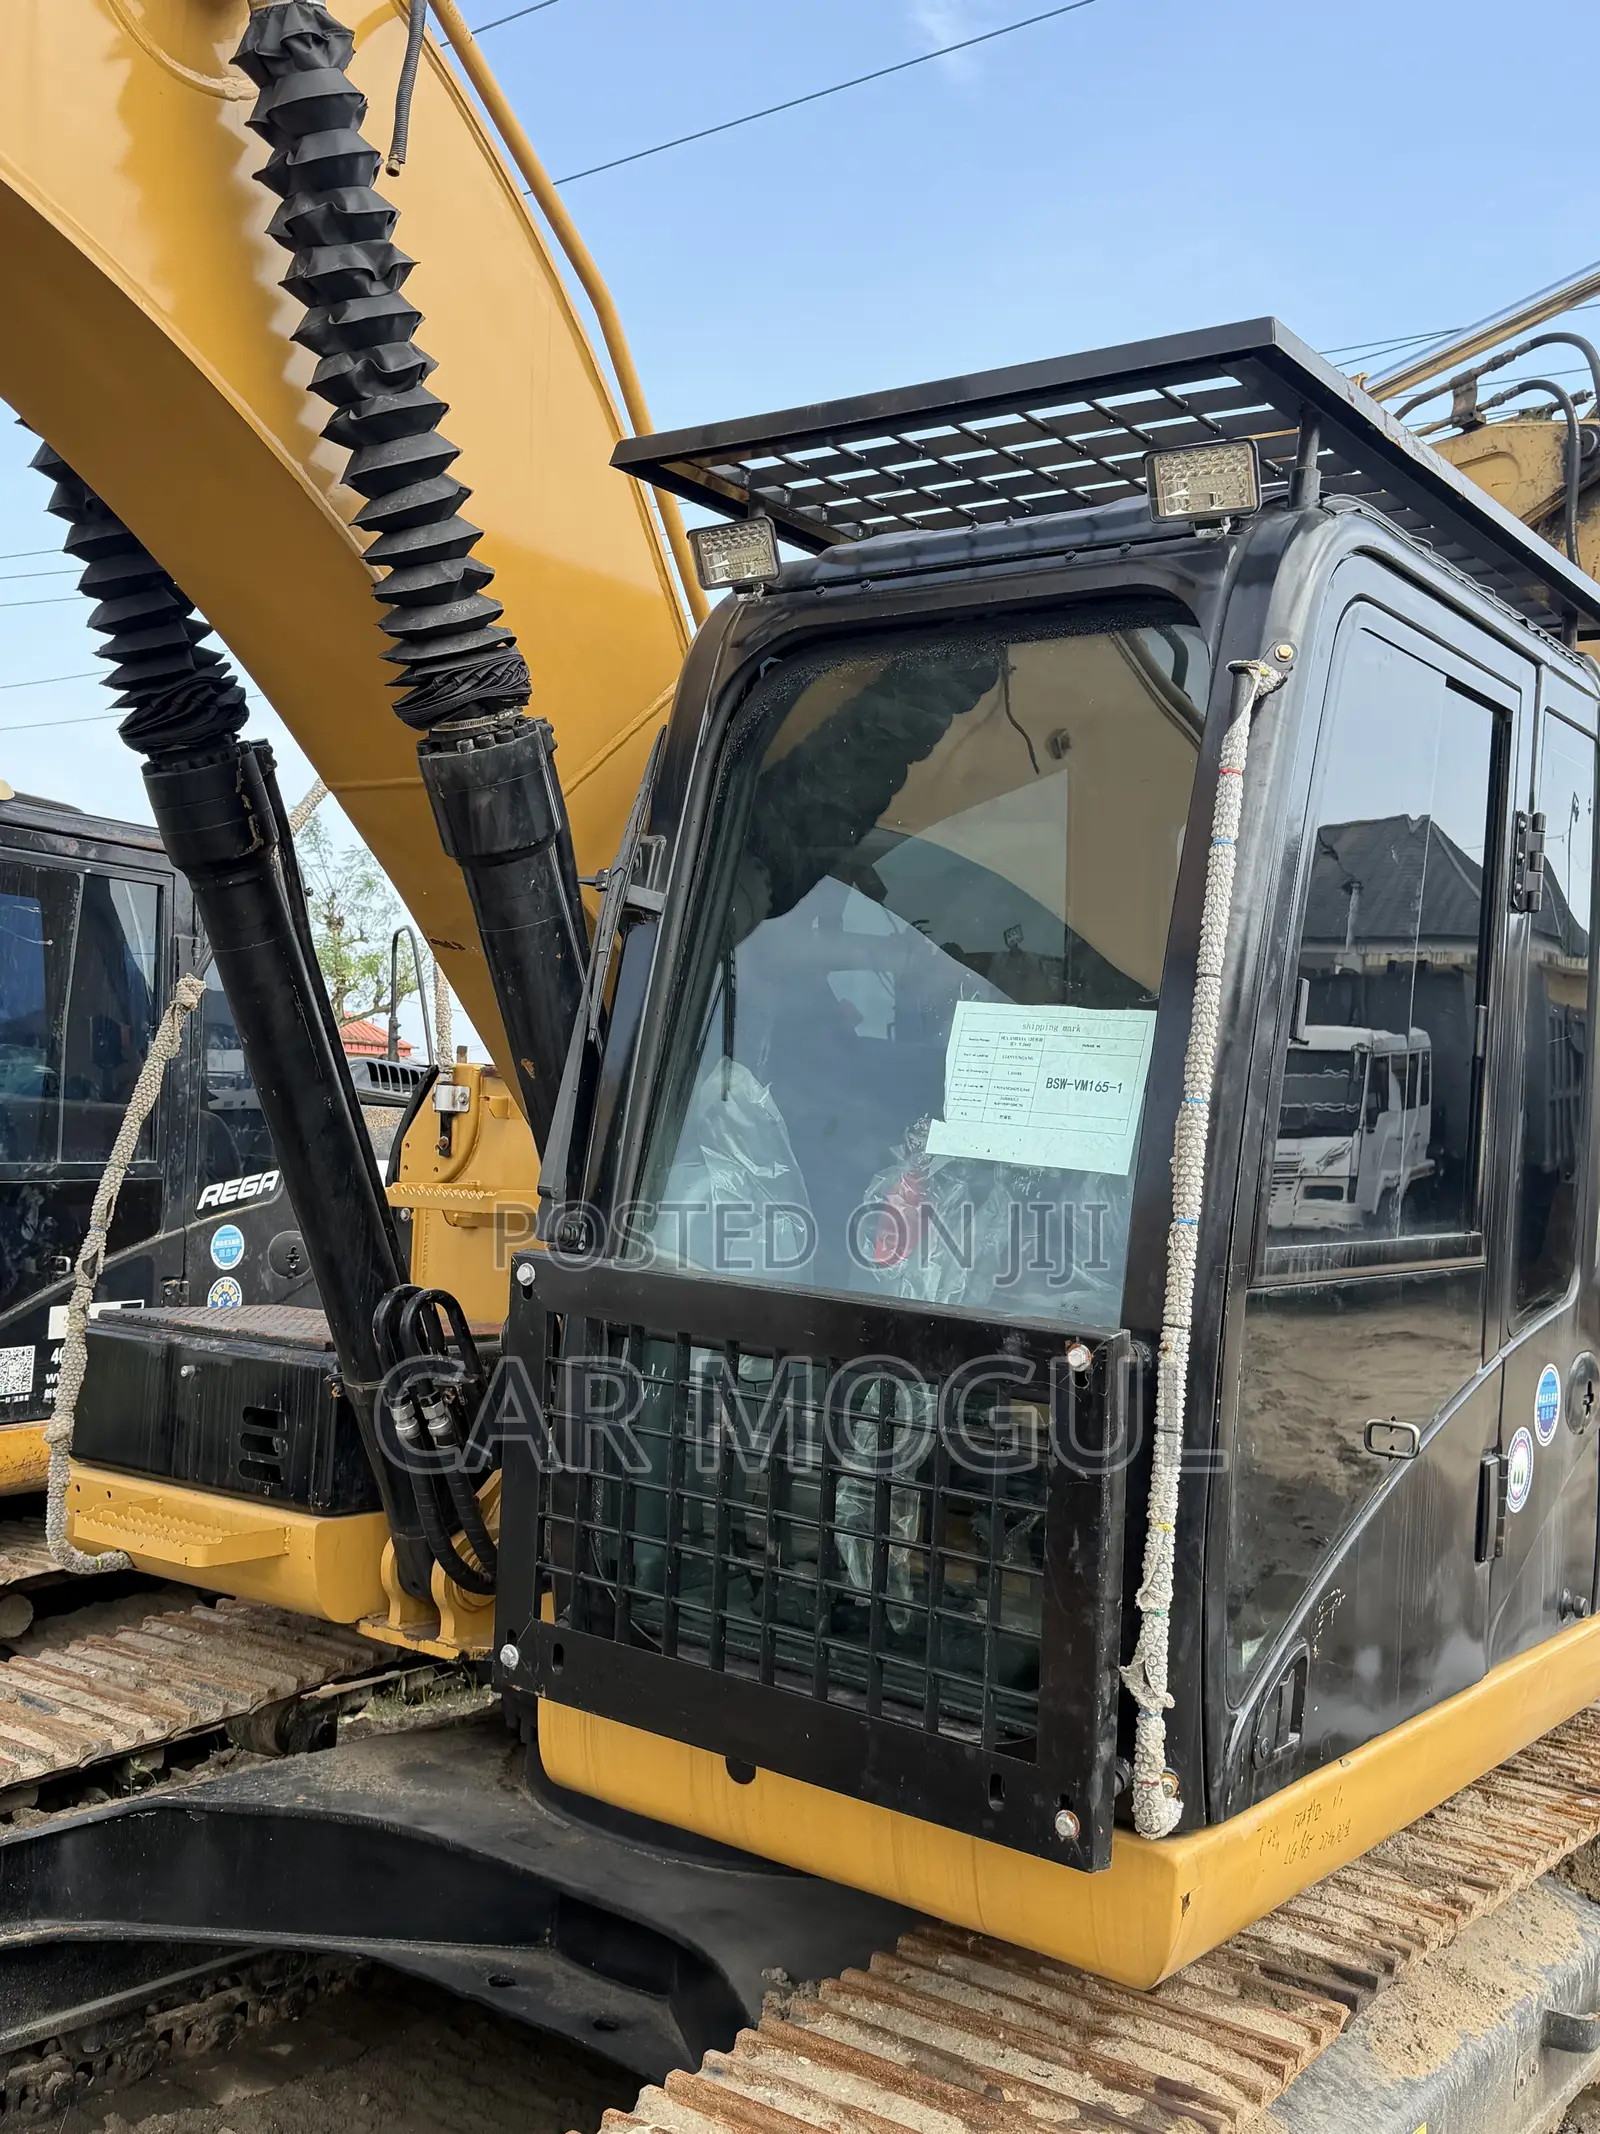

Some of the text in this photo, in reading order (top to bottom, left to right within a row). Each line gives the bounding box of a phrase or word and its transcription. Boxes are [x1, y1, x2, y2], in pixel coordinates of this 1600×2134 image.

[1022, 1022, 1081, 1033] shipping mark
[1046, 1077, 1123, 1094] BSW-VM165-1
